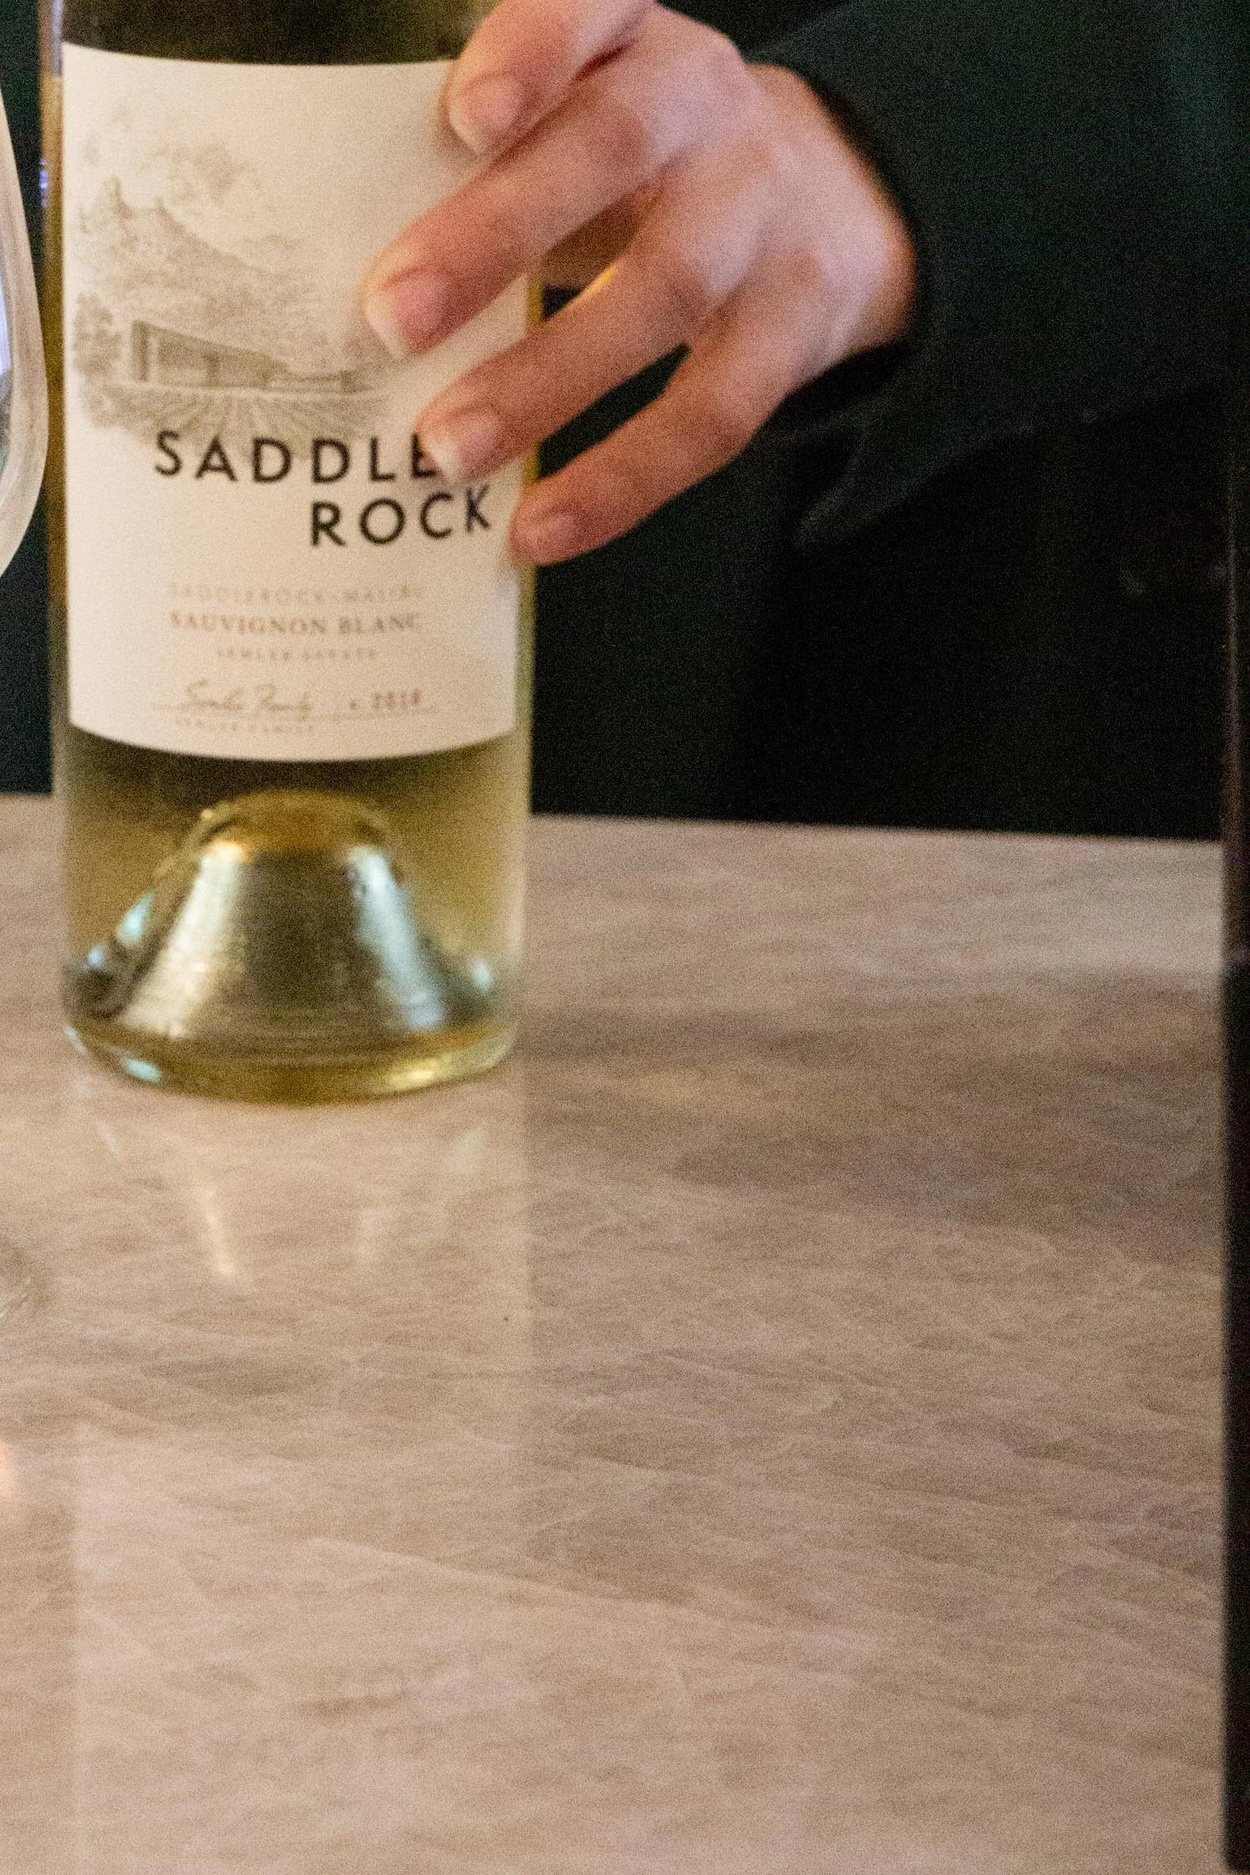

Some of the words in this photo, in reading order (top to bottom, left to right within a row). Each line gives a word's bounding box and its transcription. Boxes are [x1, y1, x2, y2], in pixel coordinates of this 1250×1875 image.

[310, 484, 491, 548] ROCK
[169, 609, 328, 636] SAUVIGNON
[338, 611, 423, 635] BLANC
